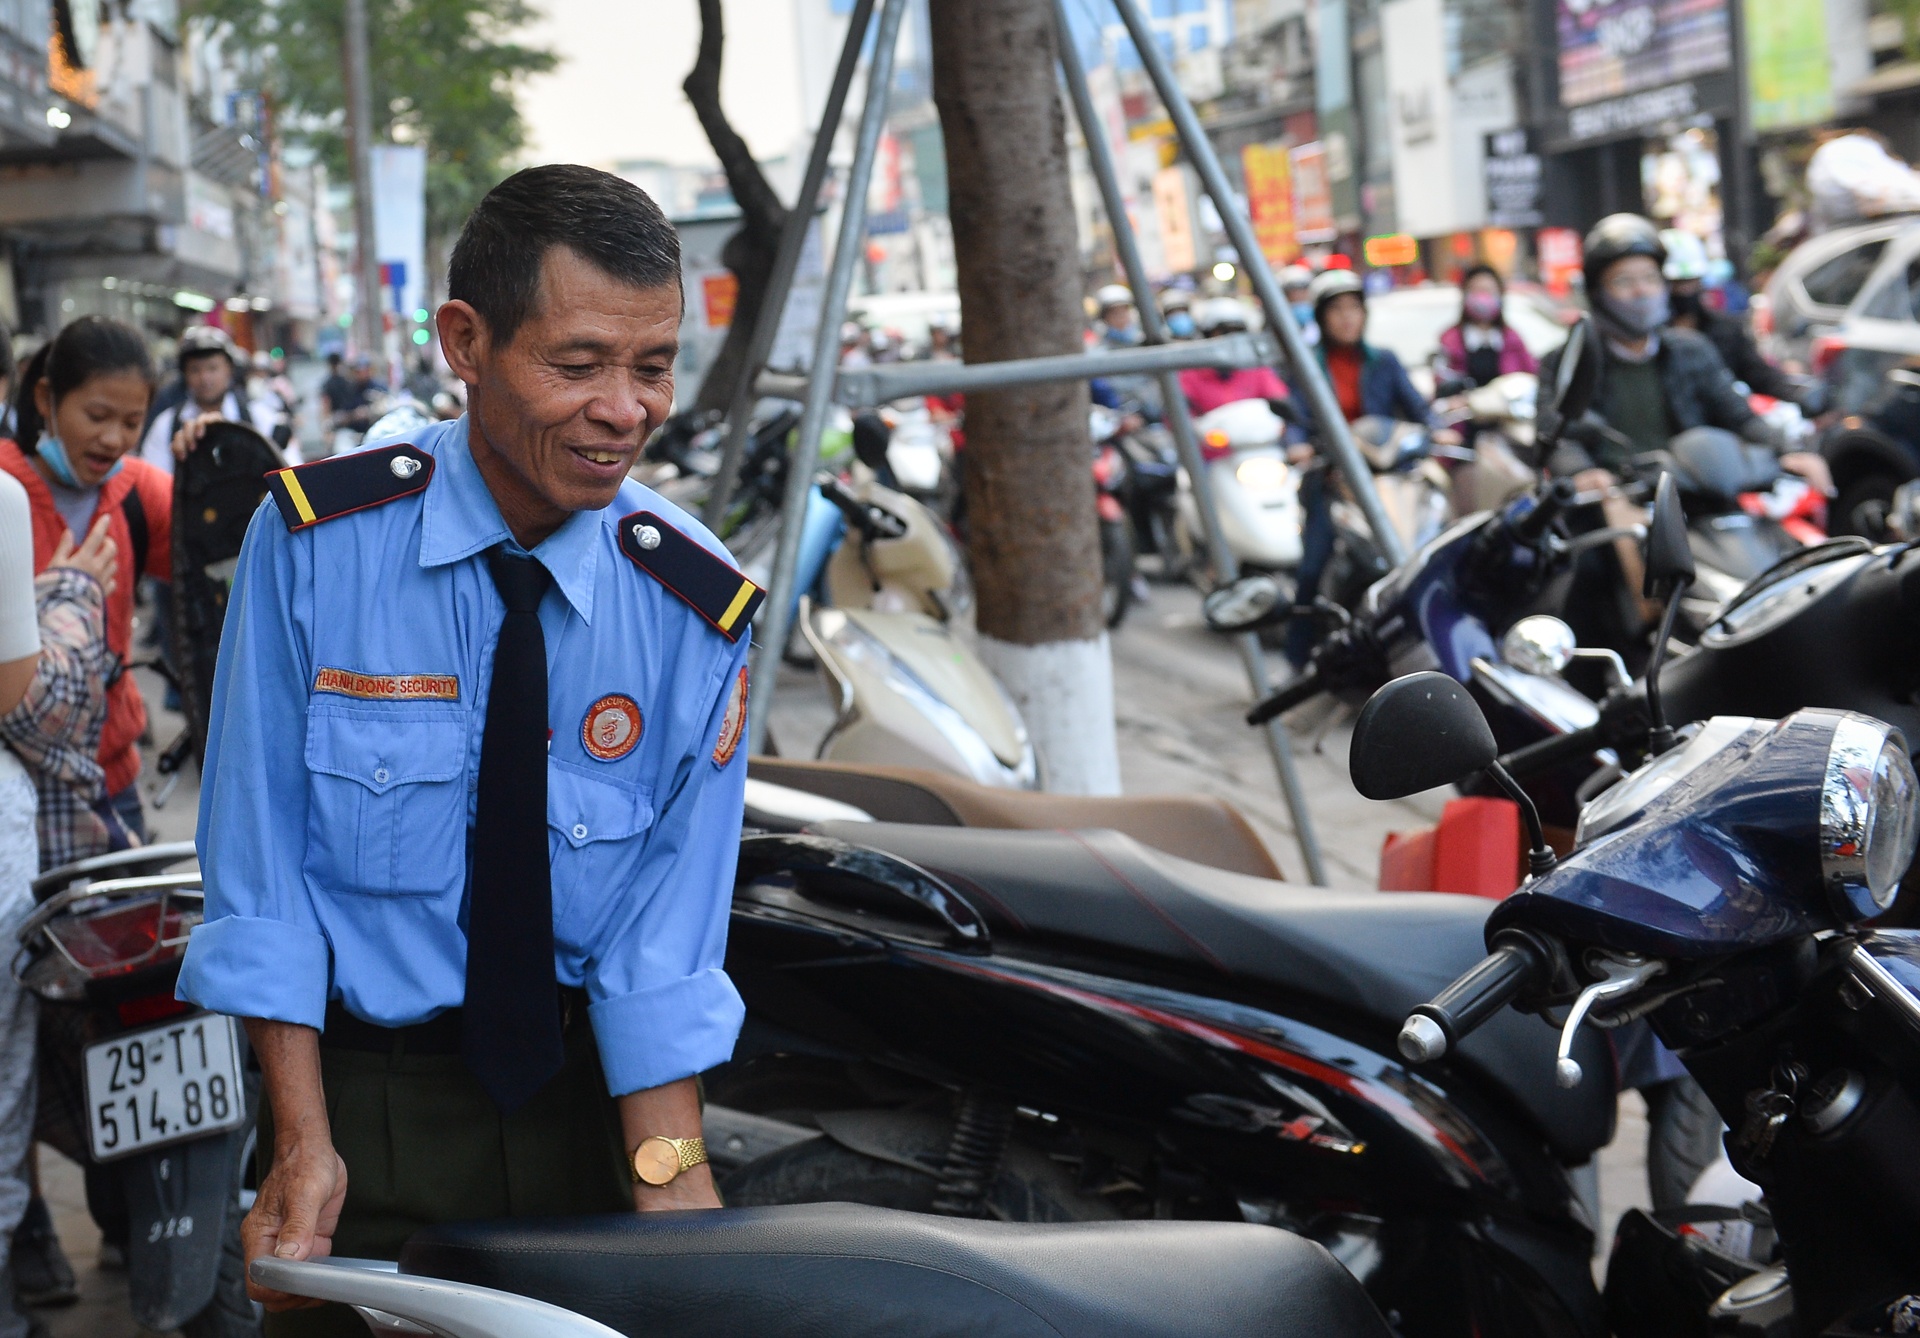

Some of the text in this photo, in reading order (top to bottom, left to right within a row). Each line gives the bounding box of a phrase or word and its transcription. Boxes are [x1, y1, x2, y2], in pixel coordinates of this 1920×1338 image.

[355, 677, 396, 694] DONG
[399, 679, 457, 695] SECURITY
[98, 1074, 229, 1149] 514.88
